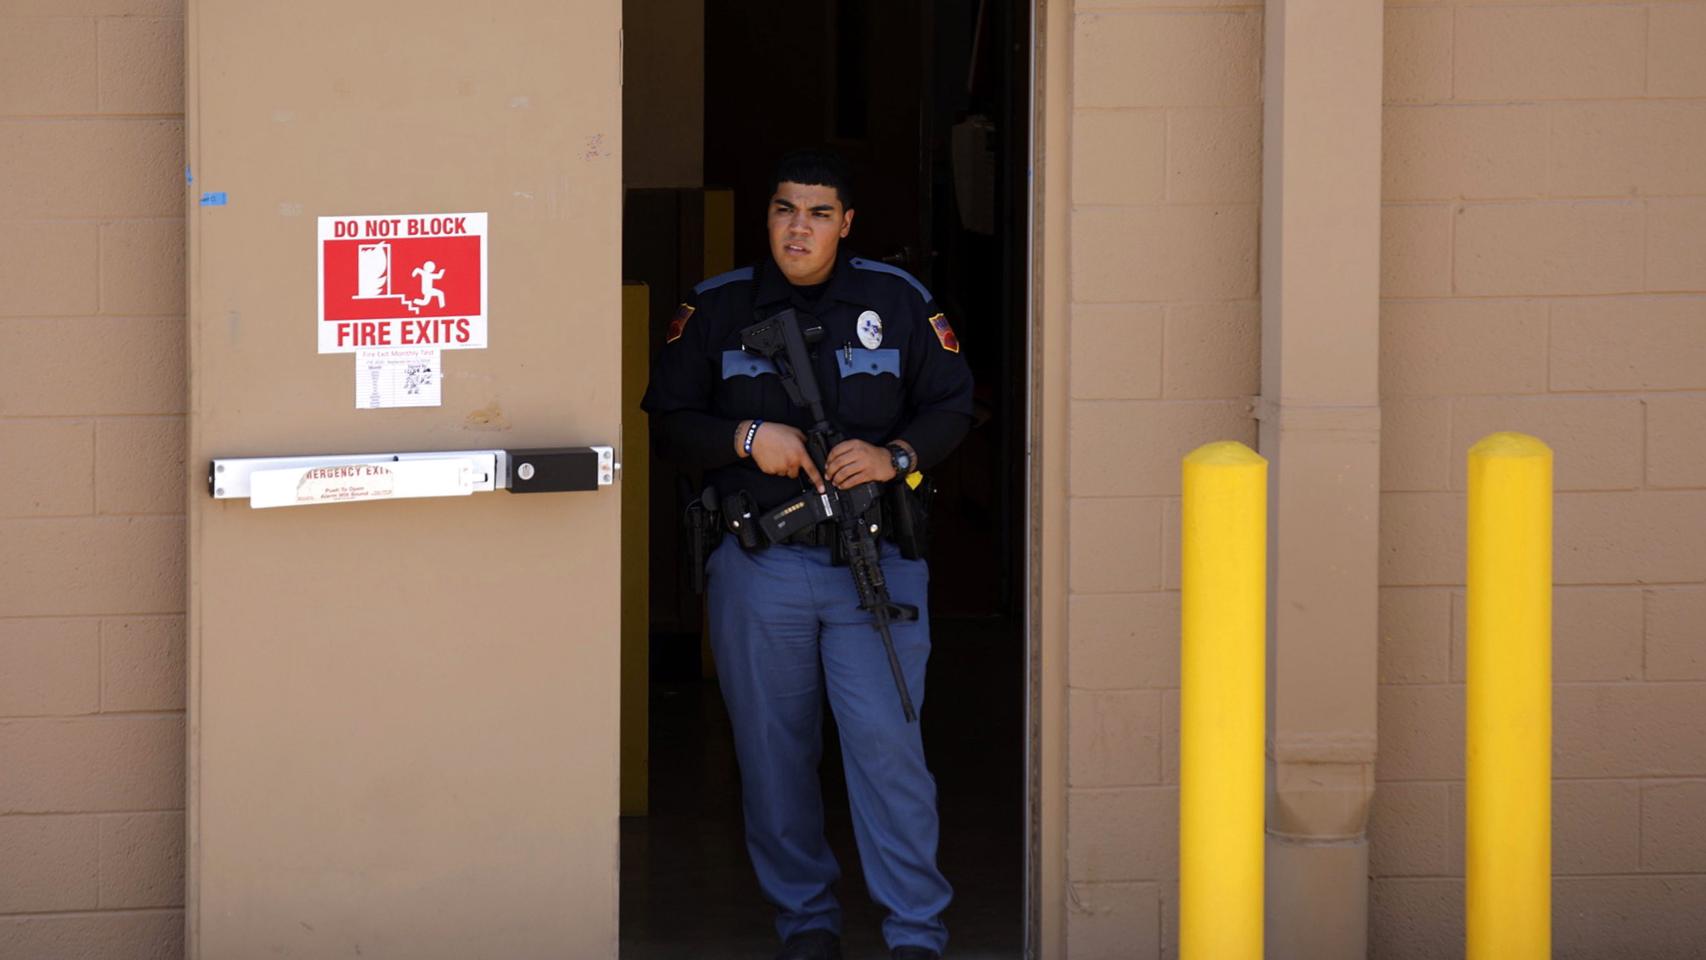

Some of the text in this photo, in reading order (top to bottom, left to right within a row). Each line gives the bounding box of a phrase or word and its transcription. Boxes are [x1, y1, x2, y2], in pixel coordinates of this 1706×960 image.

[334, 217, 467, 237] DO NOT BLOCK
[337, 318, 471, 347] FIRE EXITS
